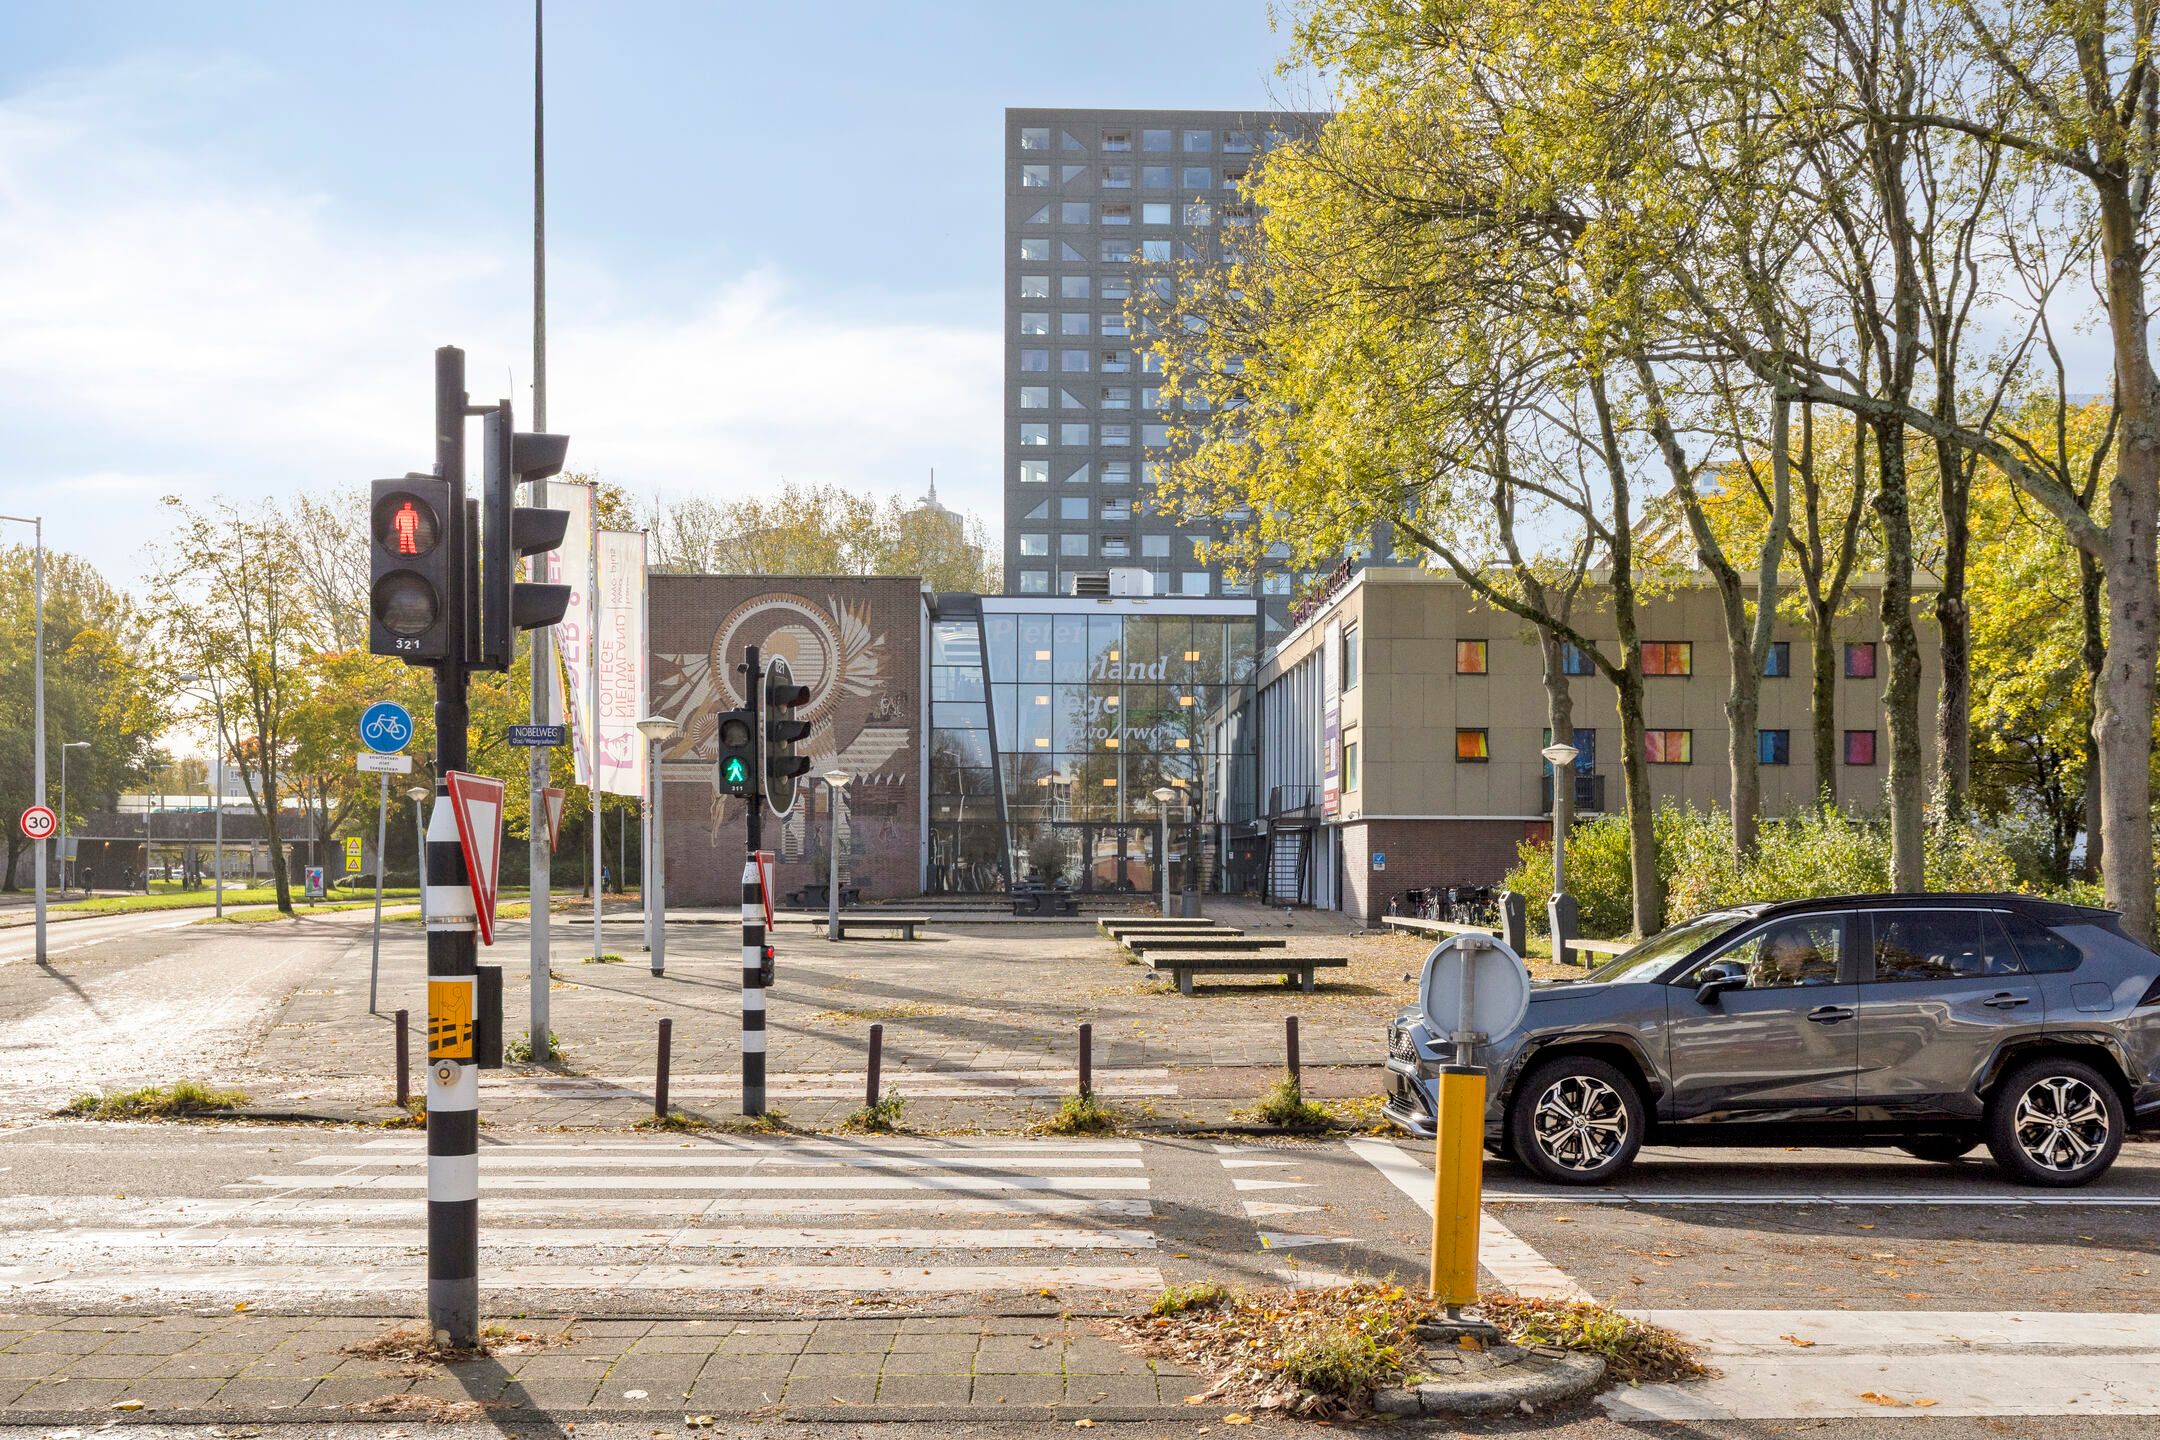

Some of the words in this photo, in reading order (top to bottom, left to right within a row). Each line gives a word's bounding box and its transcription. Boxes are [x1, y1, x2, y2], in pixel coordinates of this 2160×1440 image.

[993, 619, 1086, 644] Peter
[396, 639, 420, 650] 321
[515, 727, 558, 737] NOBELWEG
[28, 816, 50, 829] 30
